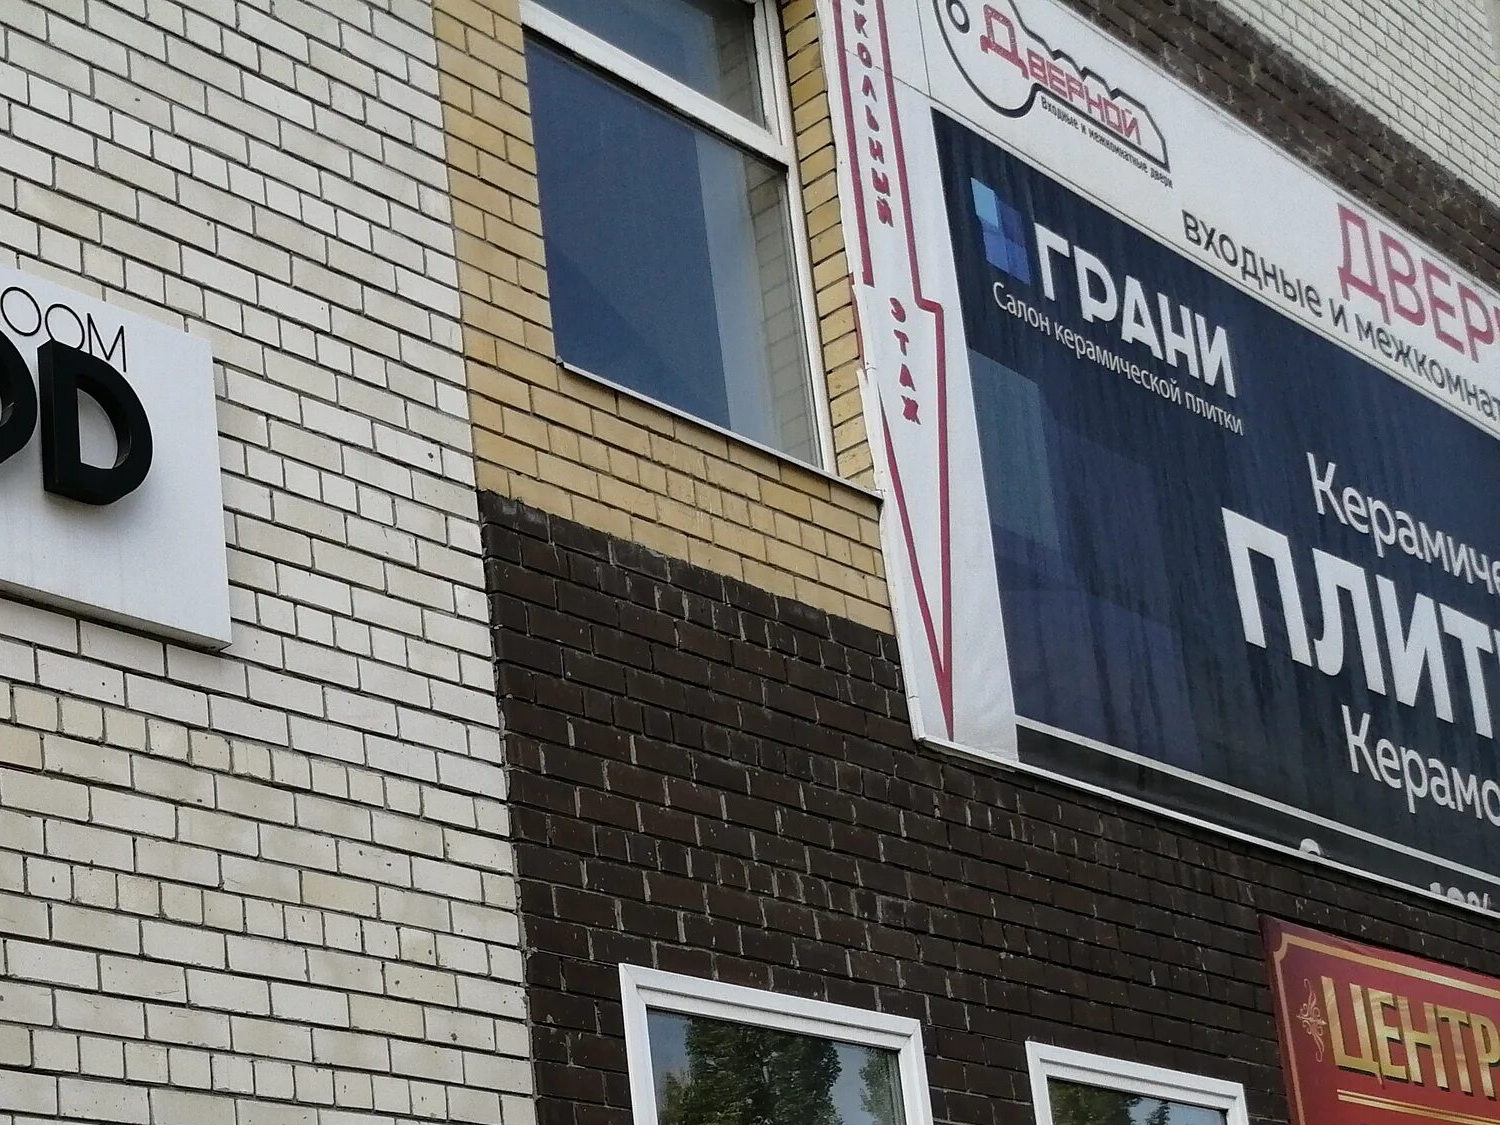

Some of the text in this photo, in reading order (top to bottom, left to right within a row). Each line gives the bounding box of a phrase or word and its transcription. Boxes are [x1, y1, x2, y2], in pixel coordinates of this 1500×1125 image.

[853, 0, 894, 227] КОЛЬНЫЙ
[1041, 95, 1079, 130] Входные
[1150, 167, 1174, 189] двери
[993, 282, 1244, 437] Салон керамической плитки
[1034, 222, 1236, 398] ГРАНИ
[1337, 203, 1500, 363] ДВЕР
[889, 297, 921, 425] ЭТАЖ
[1222, 507, 1500, 739] ПЛИТ
[1341, 704, 1500, 827] Керамо
[1321, 975, 1500, 1099] ЦЕНТР
